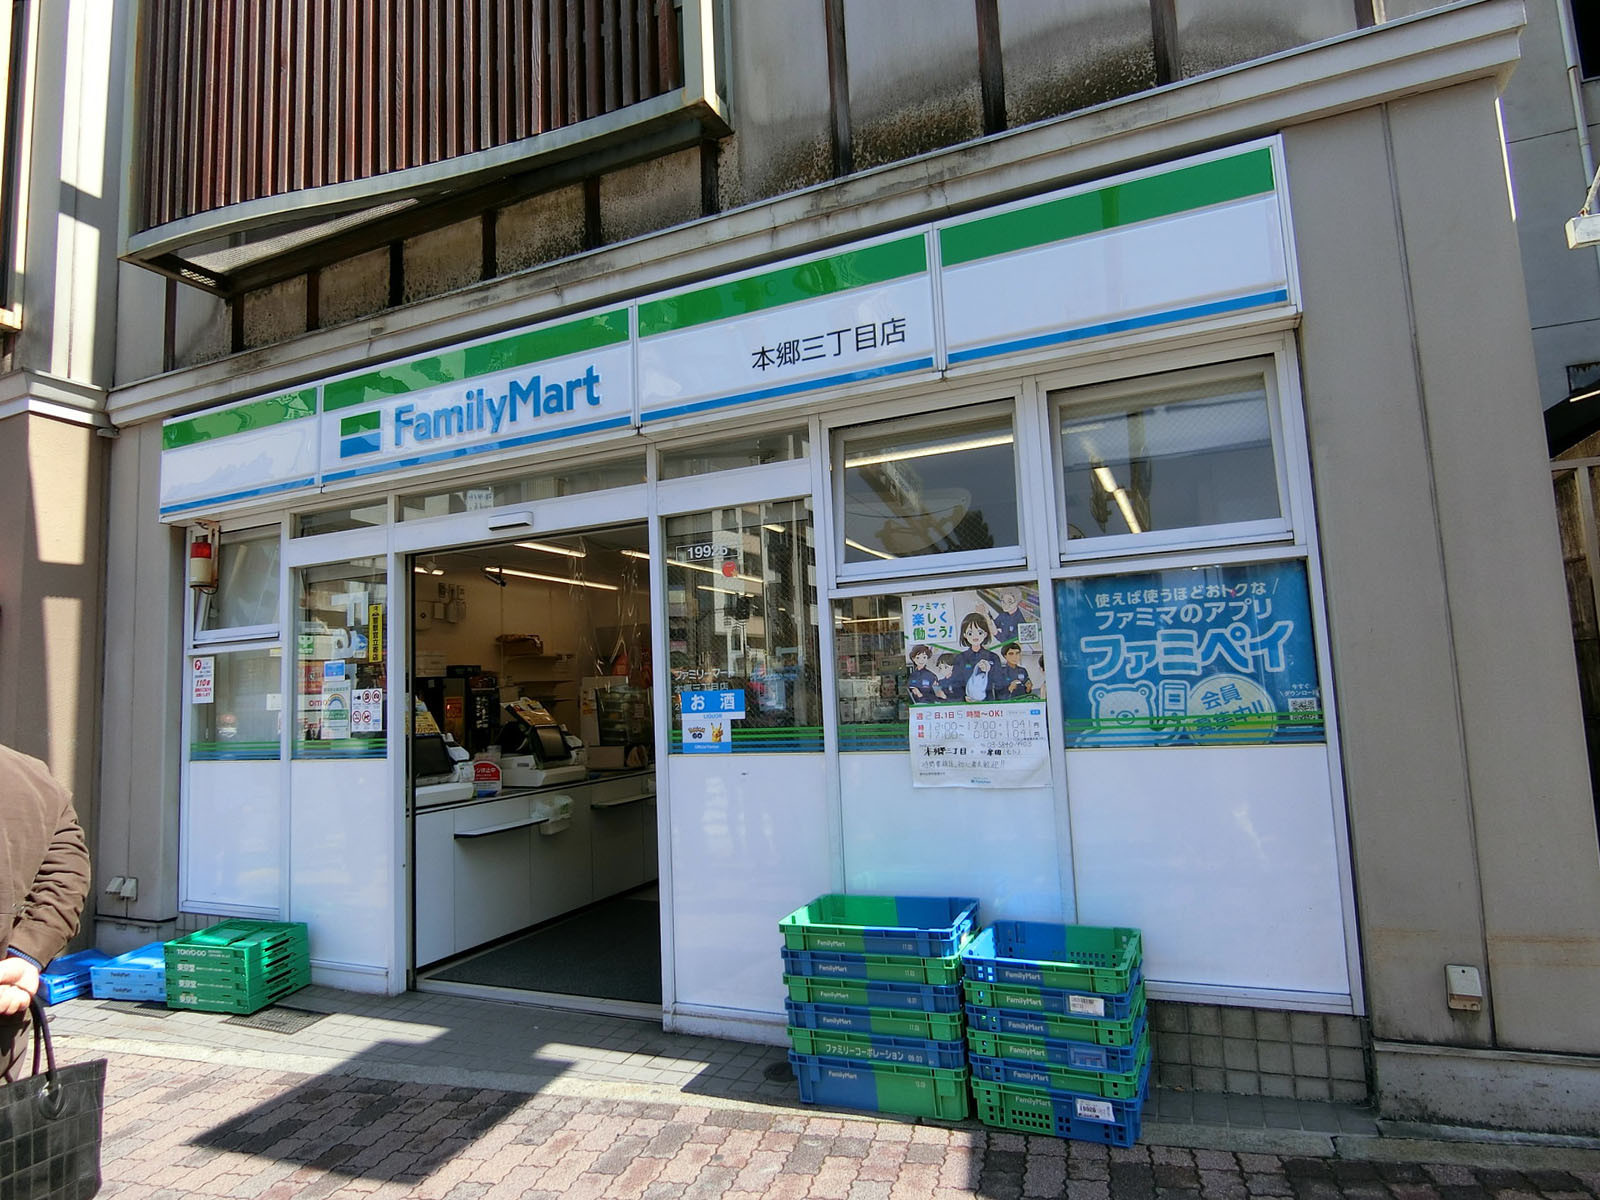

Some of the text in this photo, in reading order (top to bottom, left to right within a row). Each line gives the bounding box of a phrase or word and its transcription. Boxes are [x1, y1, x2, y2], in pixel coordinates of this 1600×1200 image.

[751, 317, 906, 372] 本郷三丁目店
[394, 365, 601, 447] FamilyMart
[1095, 581, 1267, 607] 使えば使うほどおトクな
[911, 602, 947, 612] ファミマで
[911, 611, 948, 627] 楽しく
[1095, 598, 1273, 631] ファミマのアプリ
[1080, 620, 1295, 682] ファミペイ
[1200, 683, 1243, 711] 会員
[817, 938, 846, 948] FamilyMart
[818, 964, 848, 973] FamilyMart
[1005, 970, 1041, 981] FamilyMart
[820, 990, 849, 1000] FamilyMart
[1006, 995, 1042, 1006] FamilyMart
[823, 1016, 852, 1025] FamilyMart
[1008, 1020, 1045, 1031] FamilyMart
[825, 1043, 904, 1061] ファミリーコーポレーション
[1009, 1045, 1046, 1057] FamilyMart
[828, 1070, 858, 1079] FamilyMart
[1013, 1070, 1050, 1082] FamilyMart
[1016, 1095, 1051, 1107] FamilyMart
